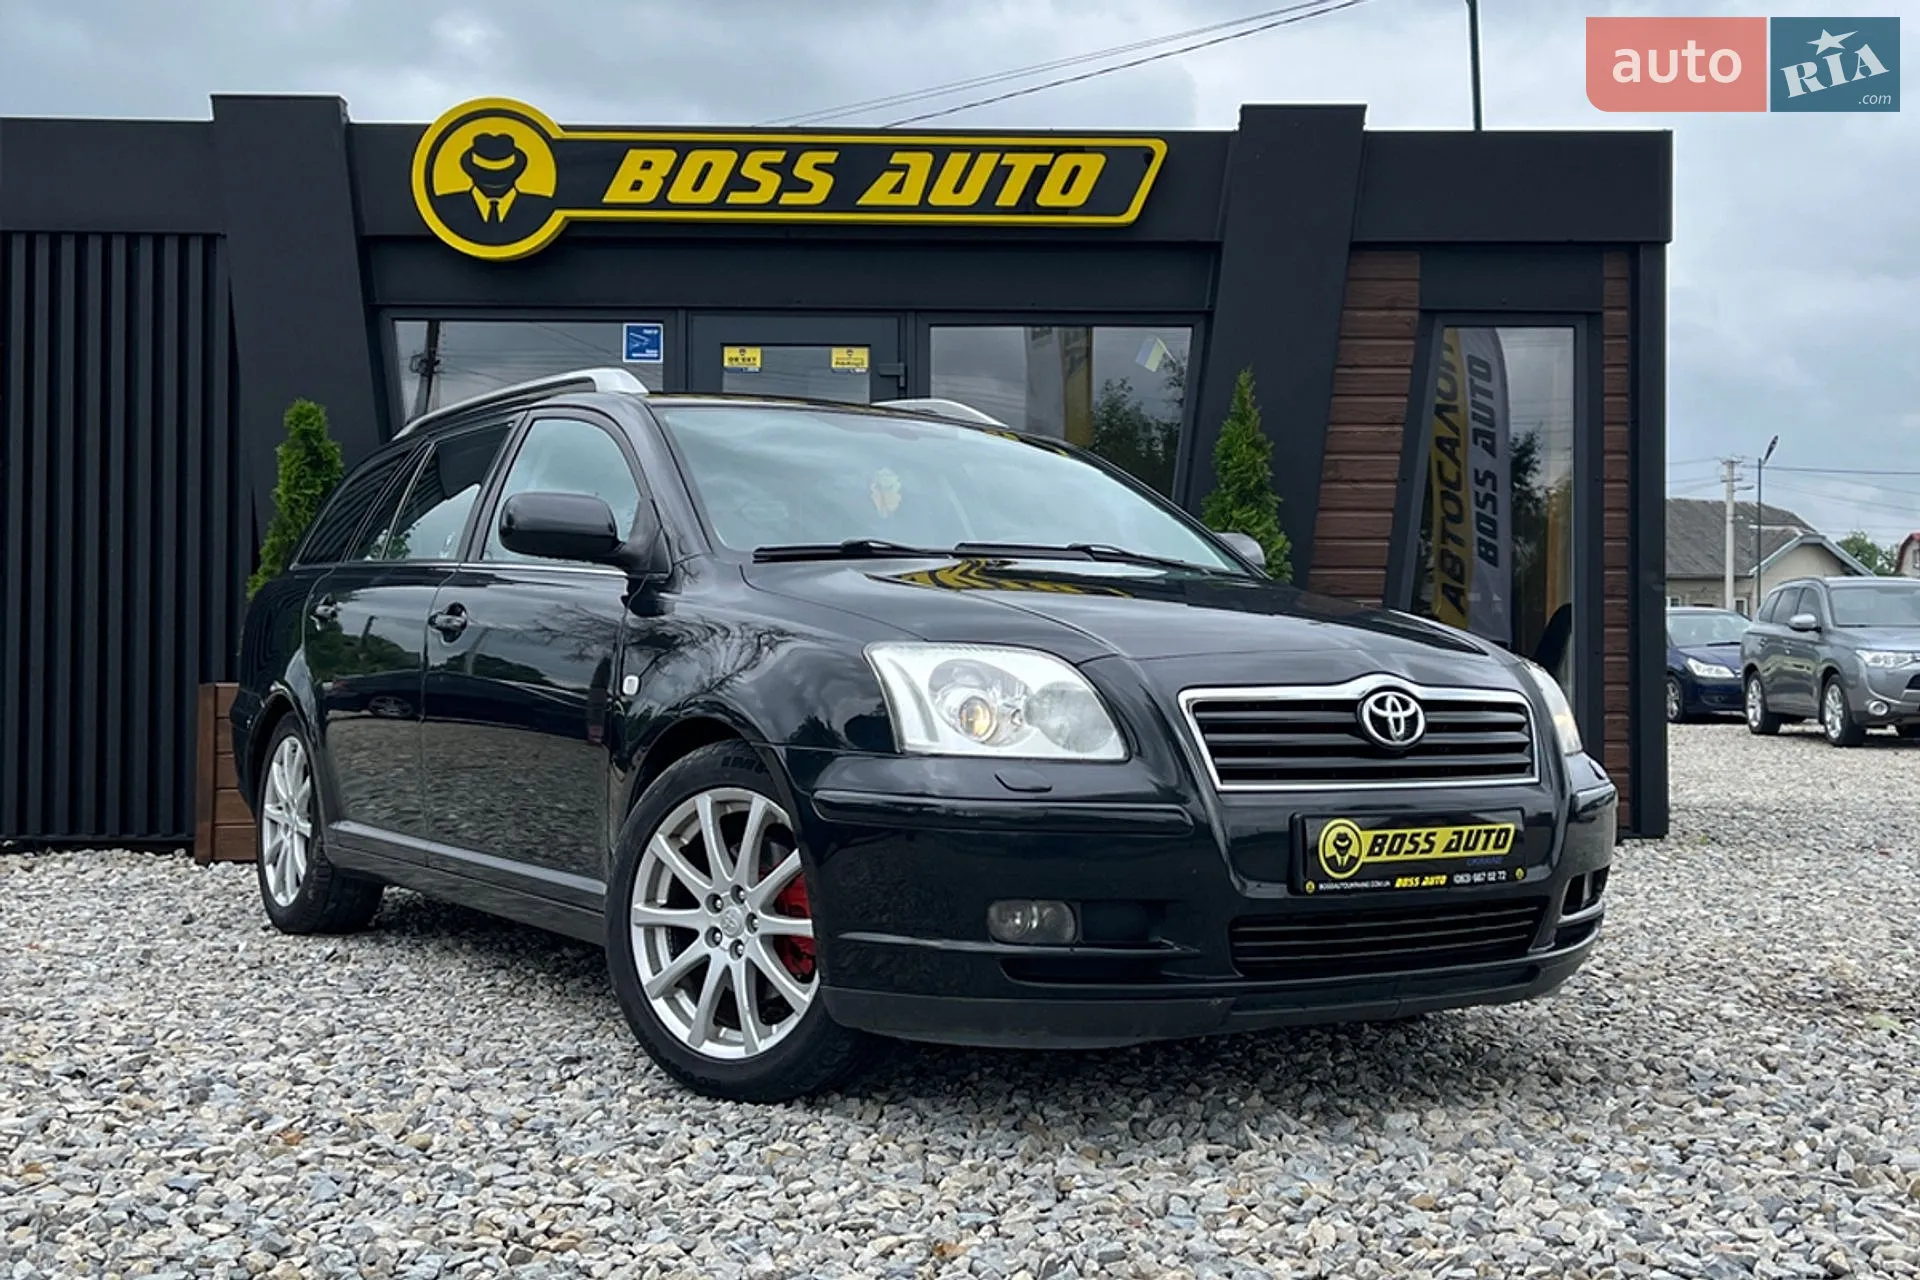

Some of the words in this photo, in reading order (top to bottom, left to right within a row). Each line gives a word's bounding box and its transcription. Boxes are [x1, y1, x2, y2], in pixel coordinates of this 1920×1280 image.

[603, 148, 839, 205] BOSS
[856, 151, 1107, 208] AUTO
[1467, 354, 1496, 458] AUTO
[1474, 467, 1499, 567] BOSS
[1367, 831, 1438, 857] BOSS
[1442, 827, 1512, 854] AUTO
[1395, 876, 1420, 888] BOSS
[1421, 875, 1448, 886] AUTO
